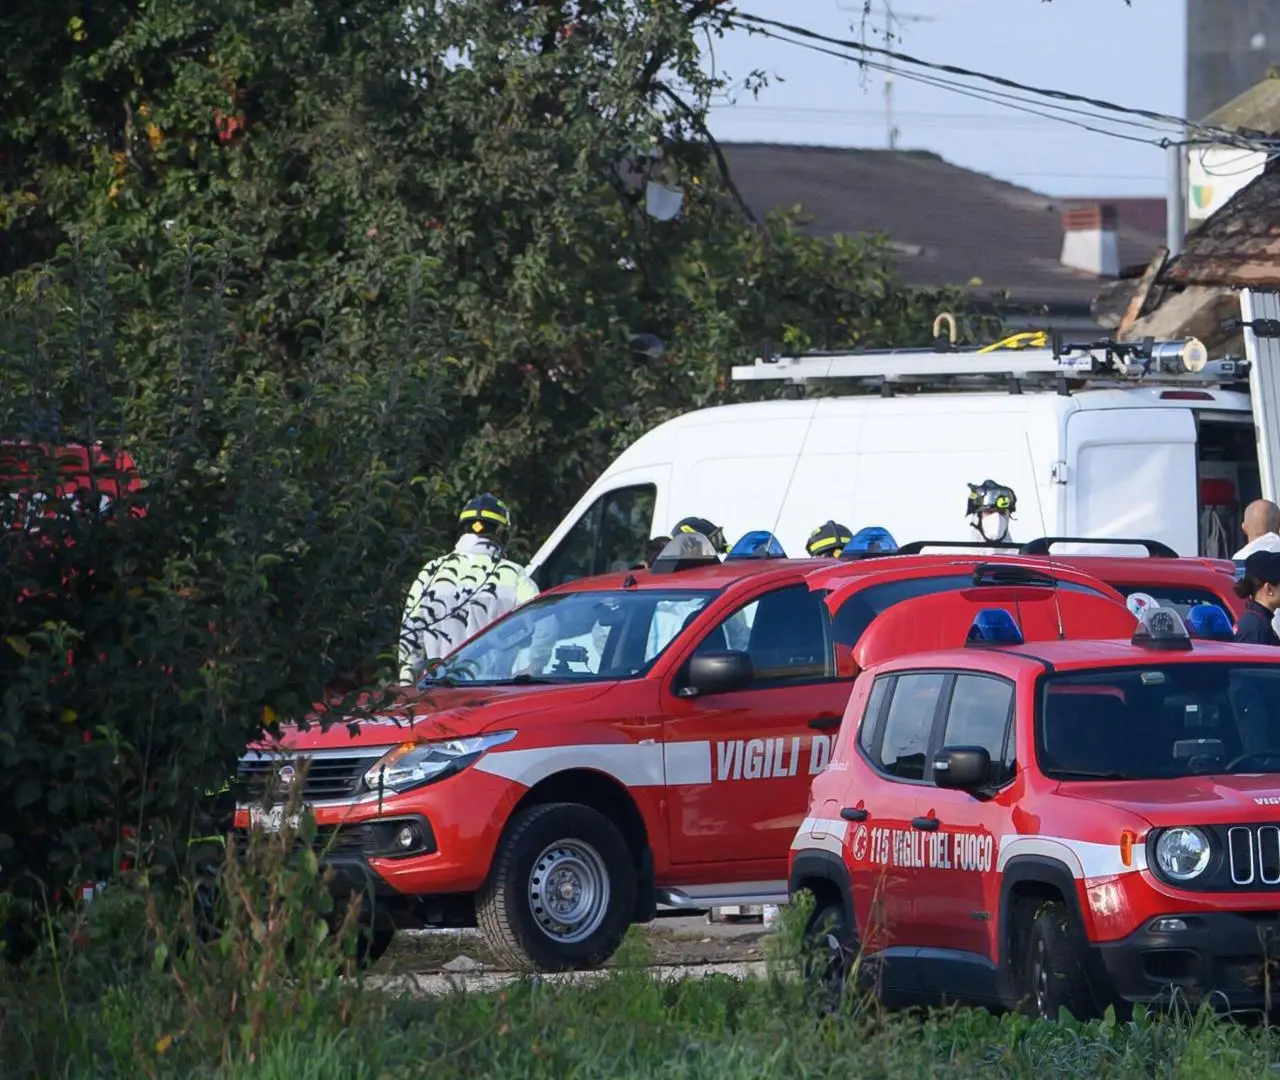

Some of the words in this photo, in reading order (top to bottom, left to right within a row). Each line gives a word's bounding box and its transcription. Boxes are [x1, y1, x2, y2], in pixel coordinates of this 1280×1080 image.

[717, 736, 800, 781] VIGILI
[870, 827, 890, 865] 115
[892, 829, 925, 867] VIGILI
[929, 832, 951, 869] DEL
[954, 833, 993, 872] FUOCO
